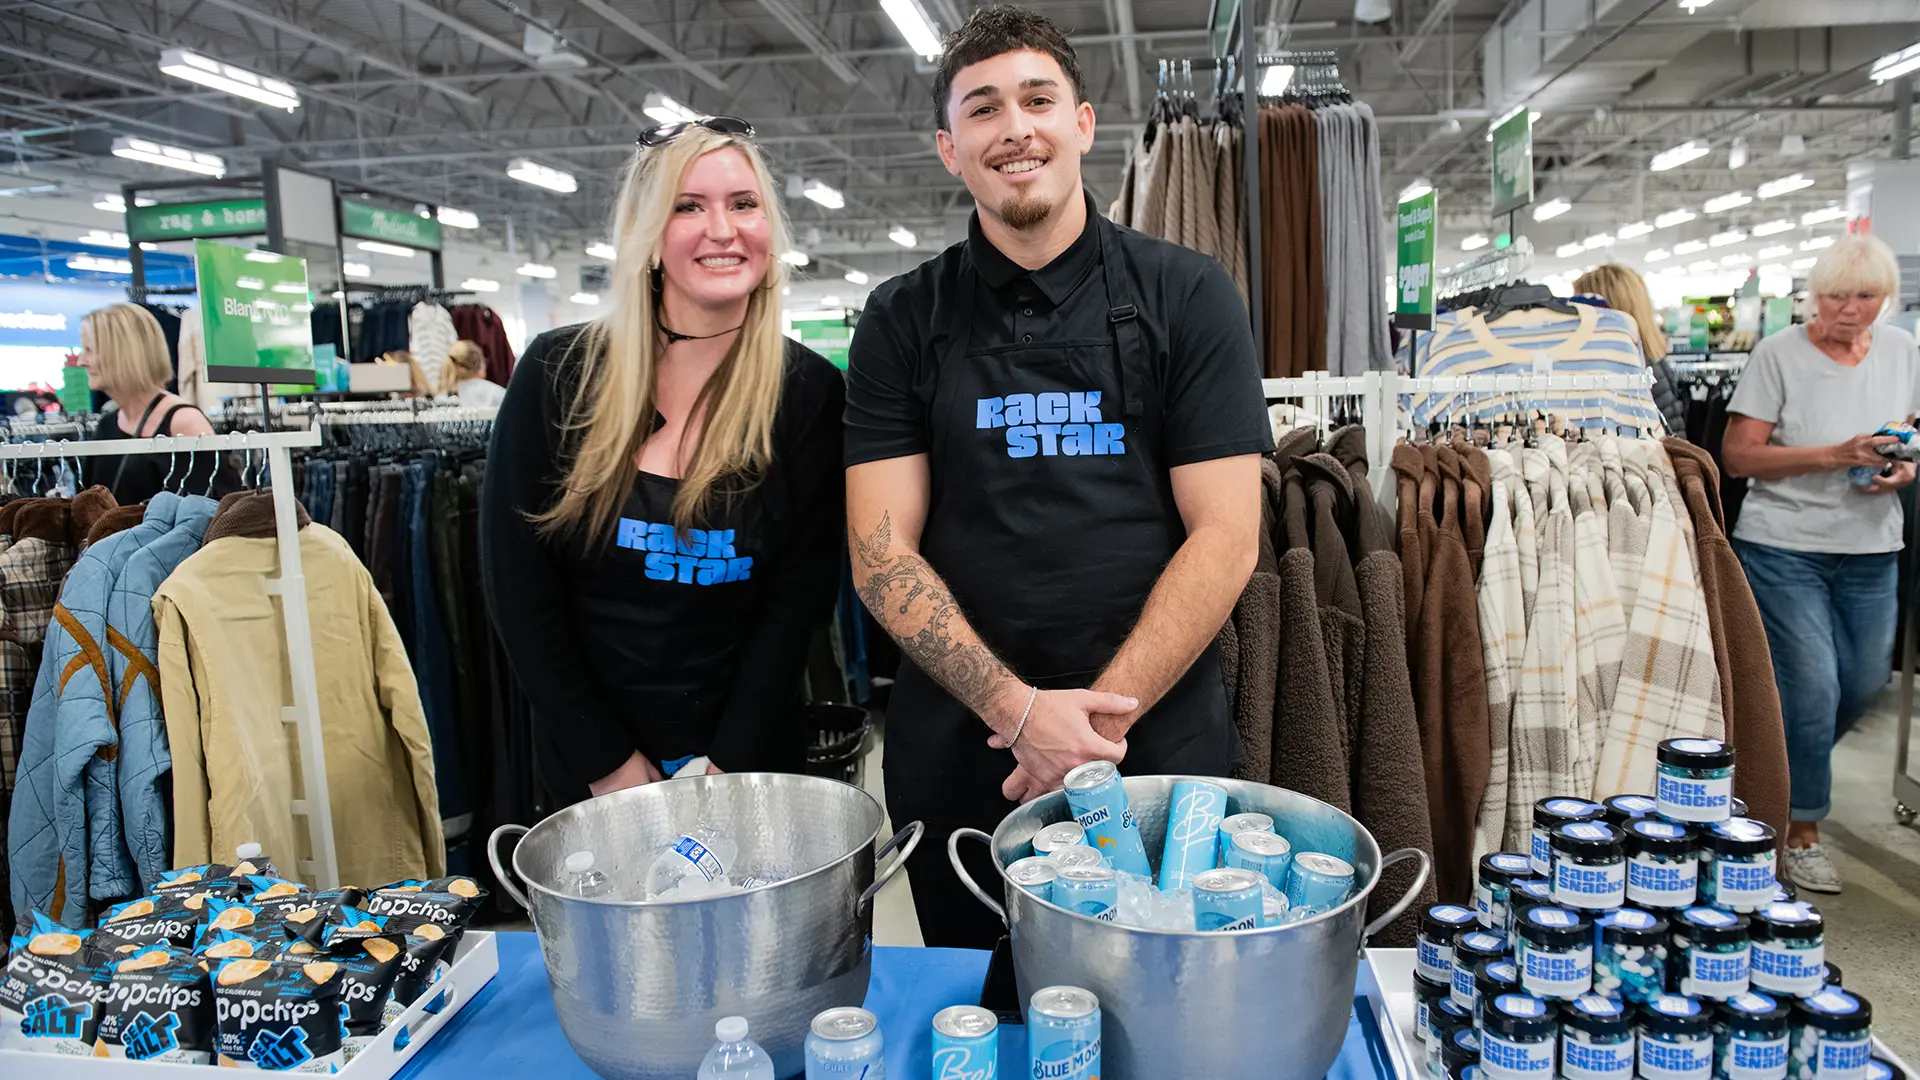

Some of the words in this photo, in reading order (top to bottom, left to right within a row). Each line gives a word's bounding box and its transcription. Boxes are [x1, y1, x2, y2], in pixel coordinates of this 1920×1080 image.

[26, 996, 64, 1016] SEA
[216, 997, 320, 1030] popchips
[20, 1003, 86, 1035] SALT
[824, 1062, 851, 1072] PURE
[1033, 1059, 1070, 1079] BLUE
